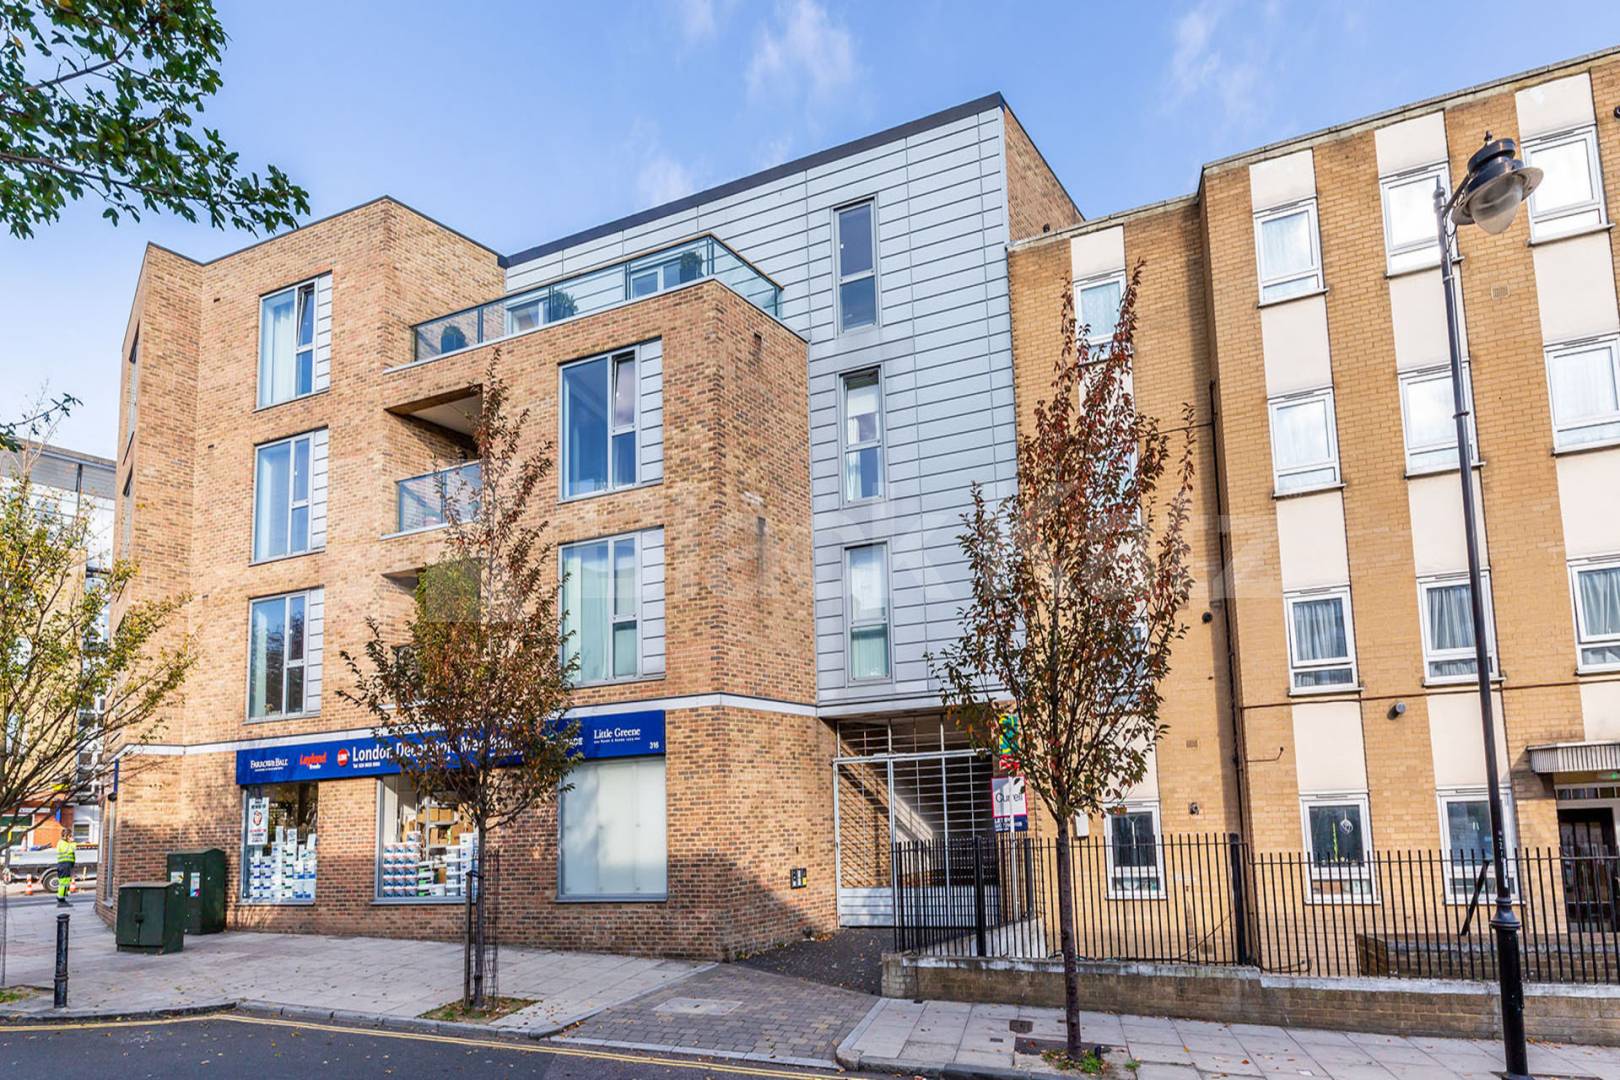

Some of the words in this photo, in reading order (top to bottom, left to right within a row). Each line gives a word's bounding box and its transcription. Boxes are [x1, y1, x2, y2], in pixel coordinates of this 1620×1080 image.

[593, 728, 613, 739] Little
[614, 727, 641, 738] Greene
[352, 744, 393, 762] London
